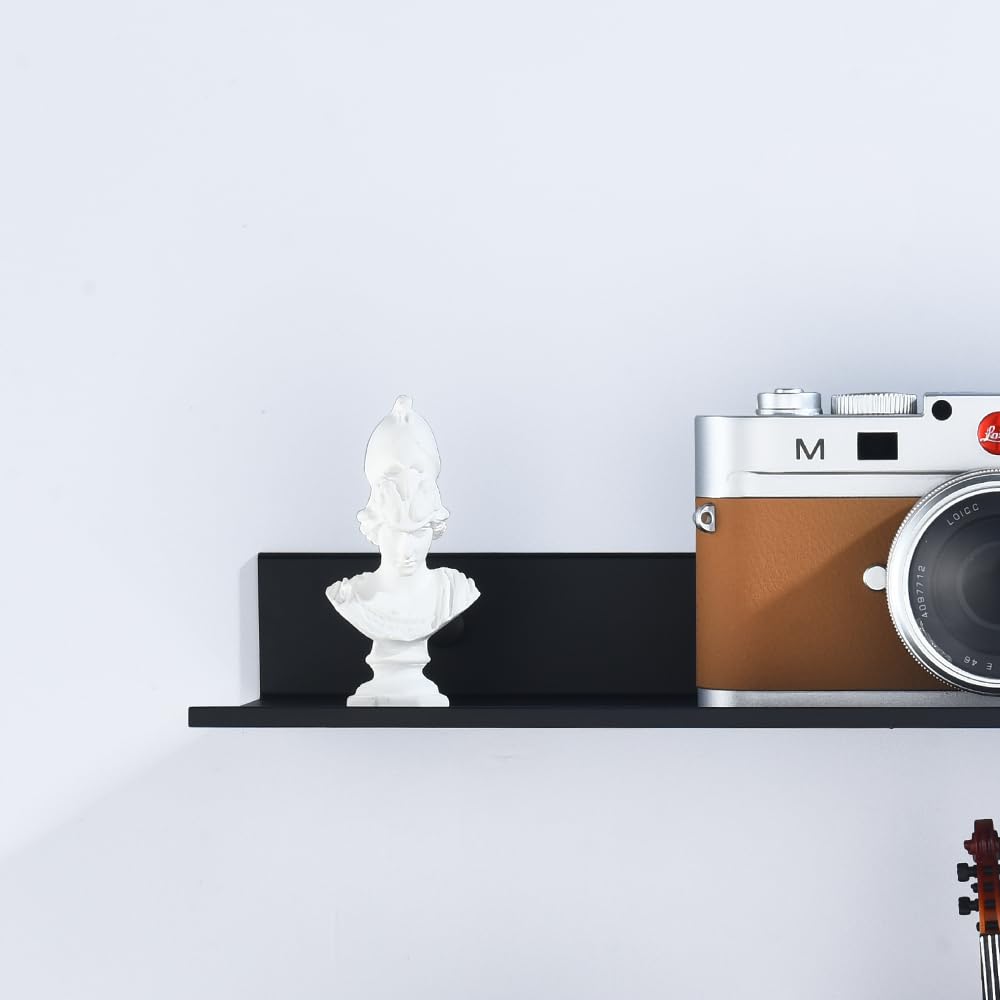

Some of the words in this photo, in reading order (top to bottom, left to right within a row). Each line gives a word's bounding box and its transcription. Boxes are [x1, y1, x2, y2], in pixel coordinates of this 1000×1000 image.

[795, 438, 825, 460] M
[963, 655, 978, 666] 46
[986, 662, 993, 671] E
